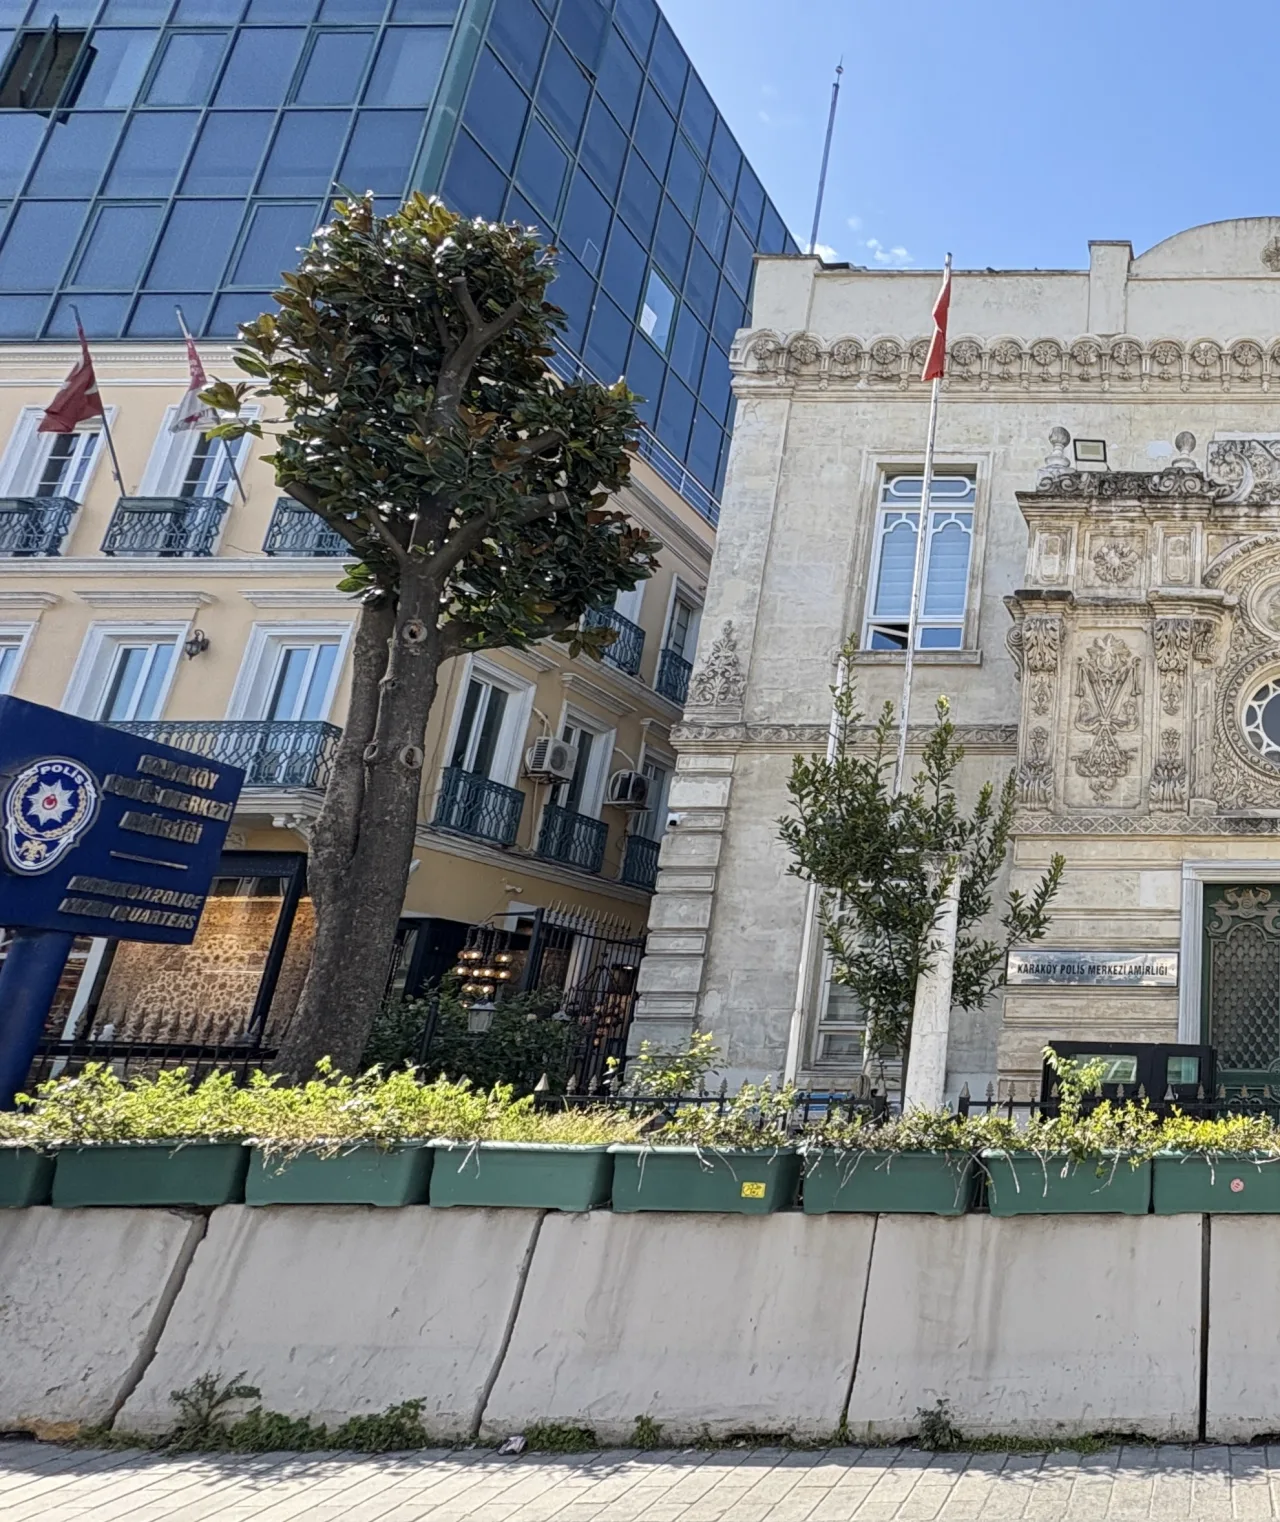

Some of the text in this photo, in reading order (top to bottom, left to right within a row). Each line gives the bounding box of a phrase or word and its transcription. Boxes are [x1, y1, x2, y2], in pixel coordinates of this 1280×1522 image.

[40, 764, 85, 784] POLİS
[1017, 961, 1057, 974] KARAKÖY
[1060, 963, 1085, 975] POLİS
[1088, 963, 1126, 975] MERKEZİ
